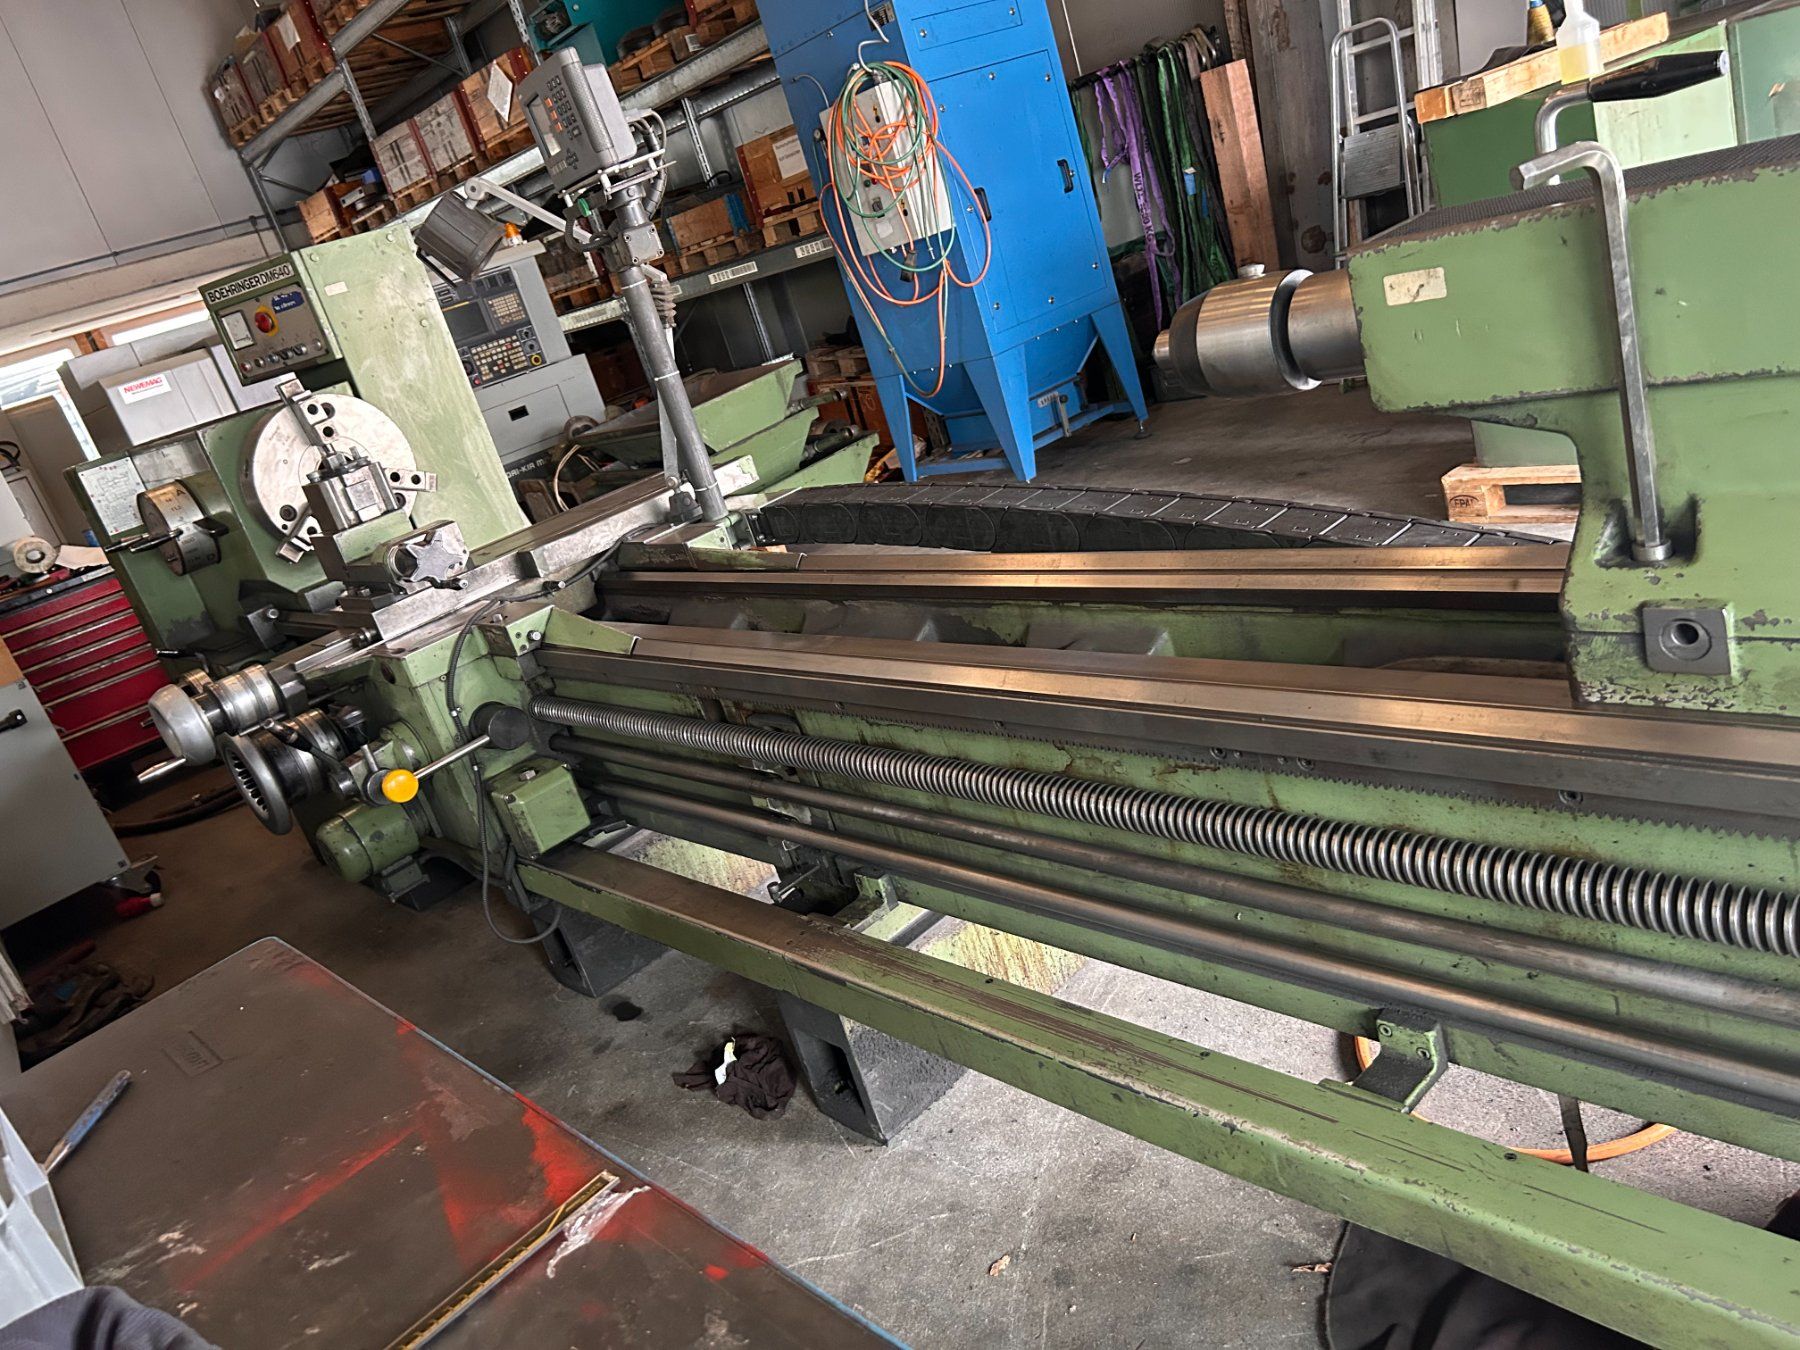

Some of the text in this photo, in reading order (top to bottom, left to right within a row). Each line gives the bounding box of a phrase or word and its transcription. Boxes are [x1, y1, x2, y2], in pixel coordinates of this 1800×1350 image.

[207, 264, 291, 302] BOEHRINGER DM640
[123, 376, 163, 393] NEWEMAG
